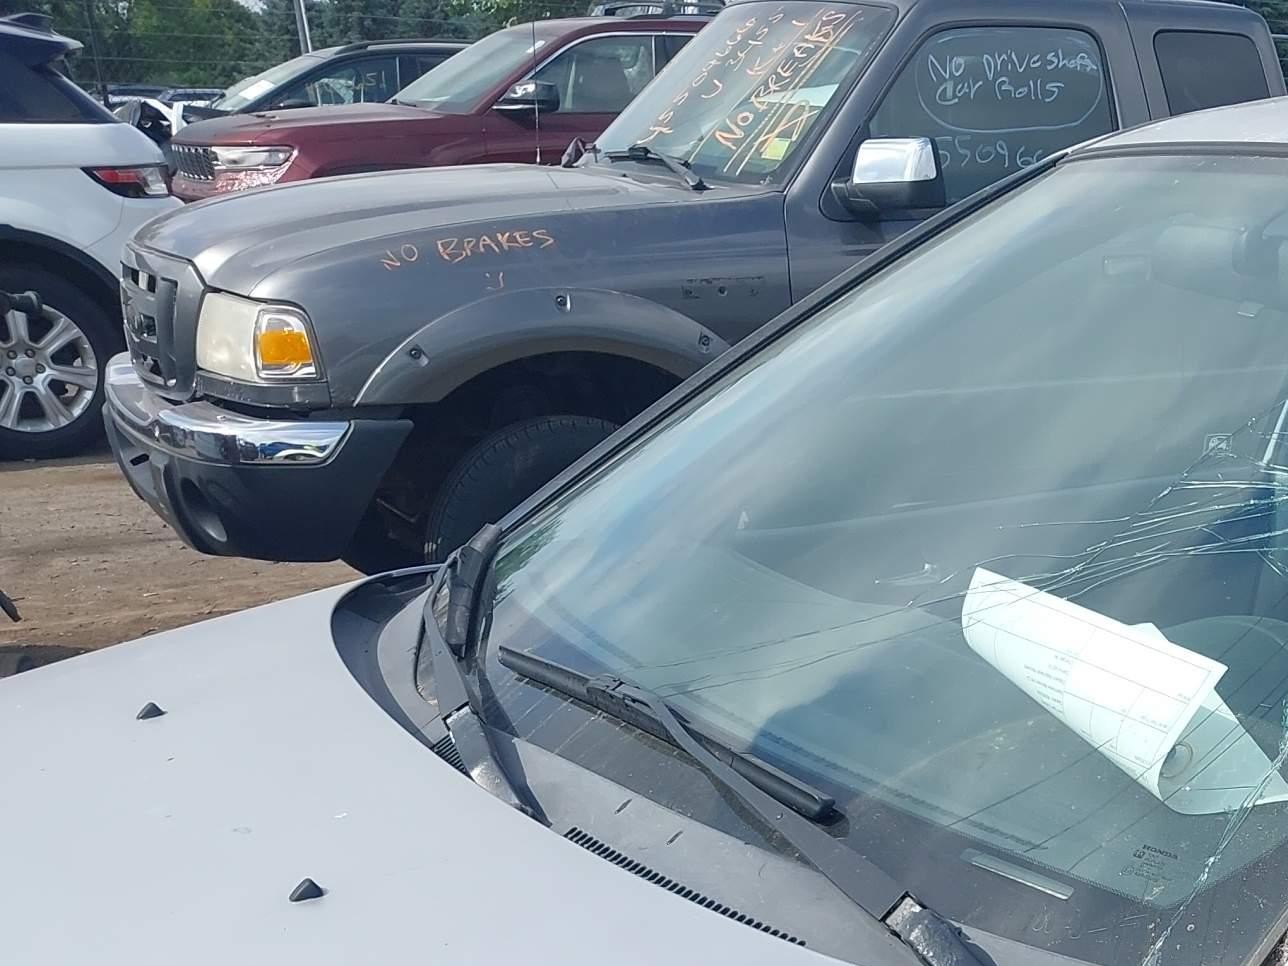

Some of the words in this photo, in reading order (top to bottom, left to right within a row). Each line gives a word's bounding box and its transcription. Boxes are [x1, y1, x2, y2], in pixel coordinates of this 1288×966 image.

[715, 111, 754, 149] NO
[380, 243, 419, 271] NO
[437, 229, 555, 264] BRAKES
